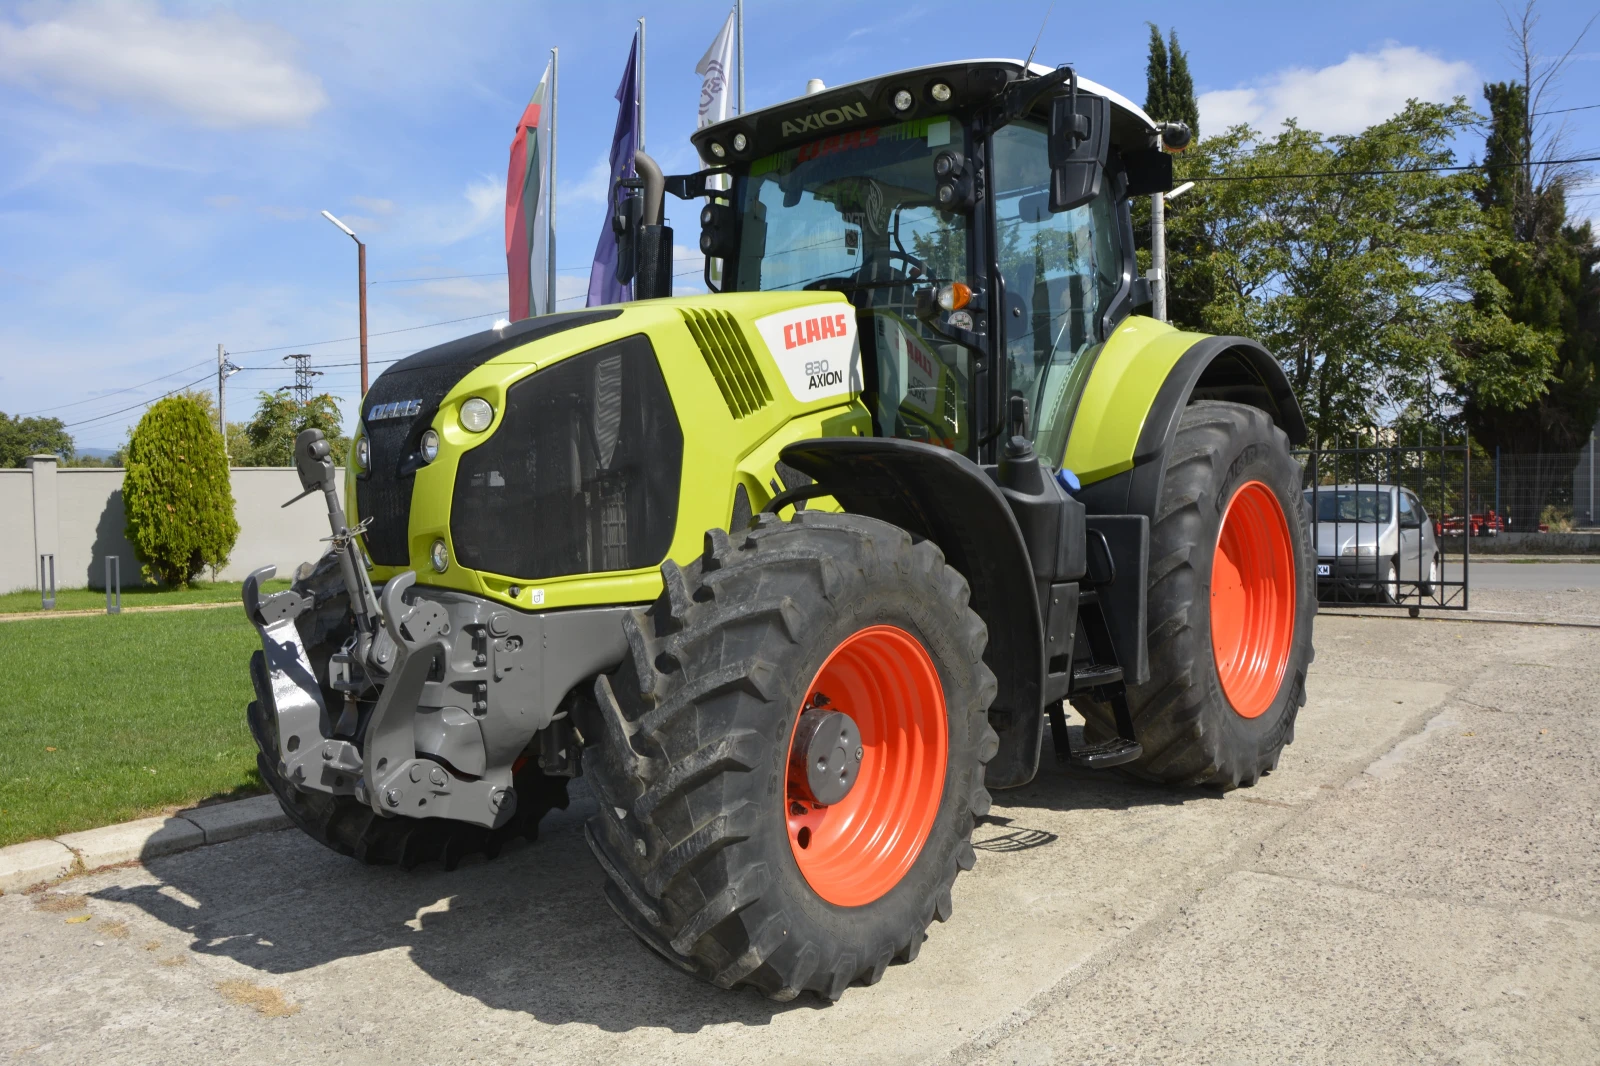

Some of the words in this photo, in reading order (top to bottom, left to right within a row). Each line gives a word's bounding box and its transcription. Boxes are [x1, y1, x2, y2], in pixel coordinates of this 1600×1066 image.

[781, 101, 868, 138] AXION
[796, 125, 881, 164] CLAAS
[783, 313, 847, 350] CLAAS
[804, 359, 829, 377] 830
[808, 370, 843, 390] AXION
[367, 398, 423, 421] CLAAS
